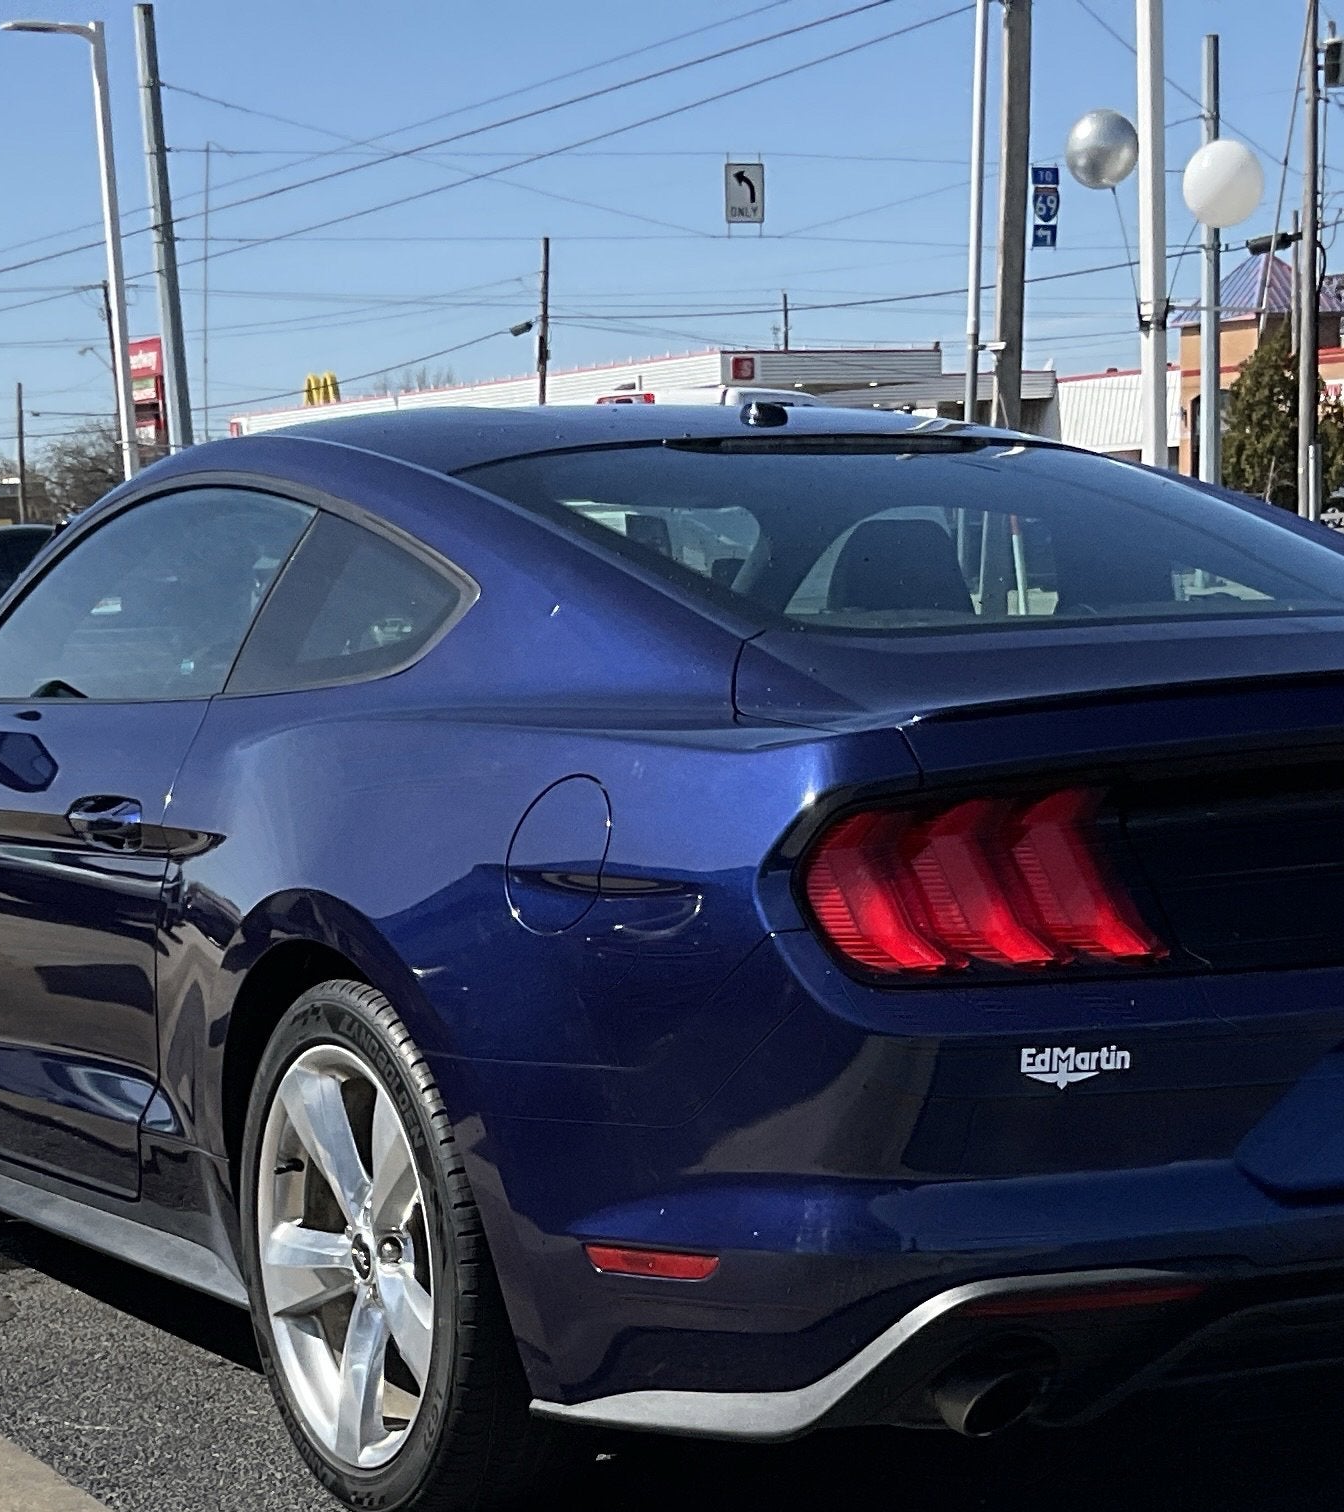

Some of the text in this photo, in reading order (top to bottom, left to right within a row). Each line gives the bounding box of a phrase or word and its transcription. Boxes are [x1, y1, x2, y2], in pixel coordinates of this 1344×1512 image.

[731, 206, 758, 217] ONLY
[1036, 195, 1057, 215] 69
[1020, 1045, 1131, 1074] EdMartin
